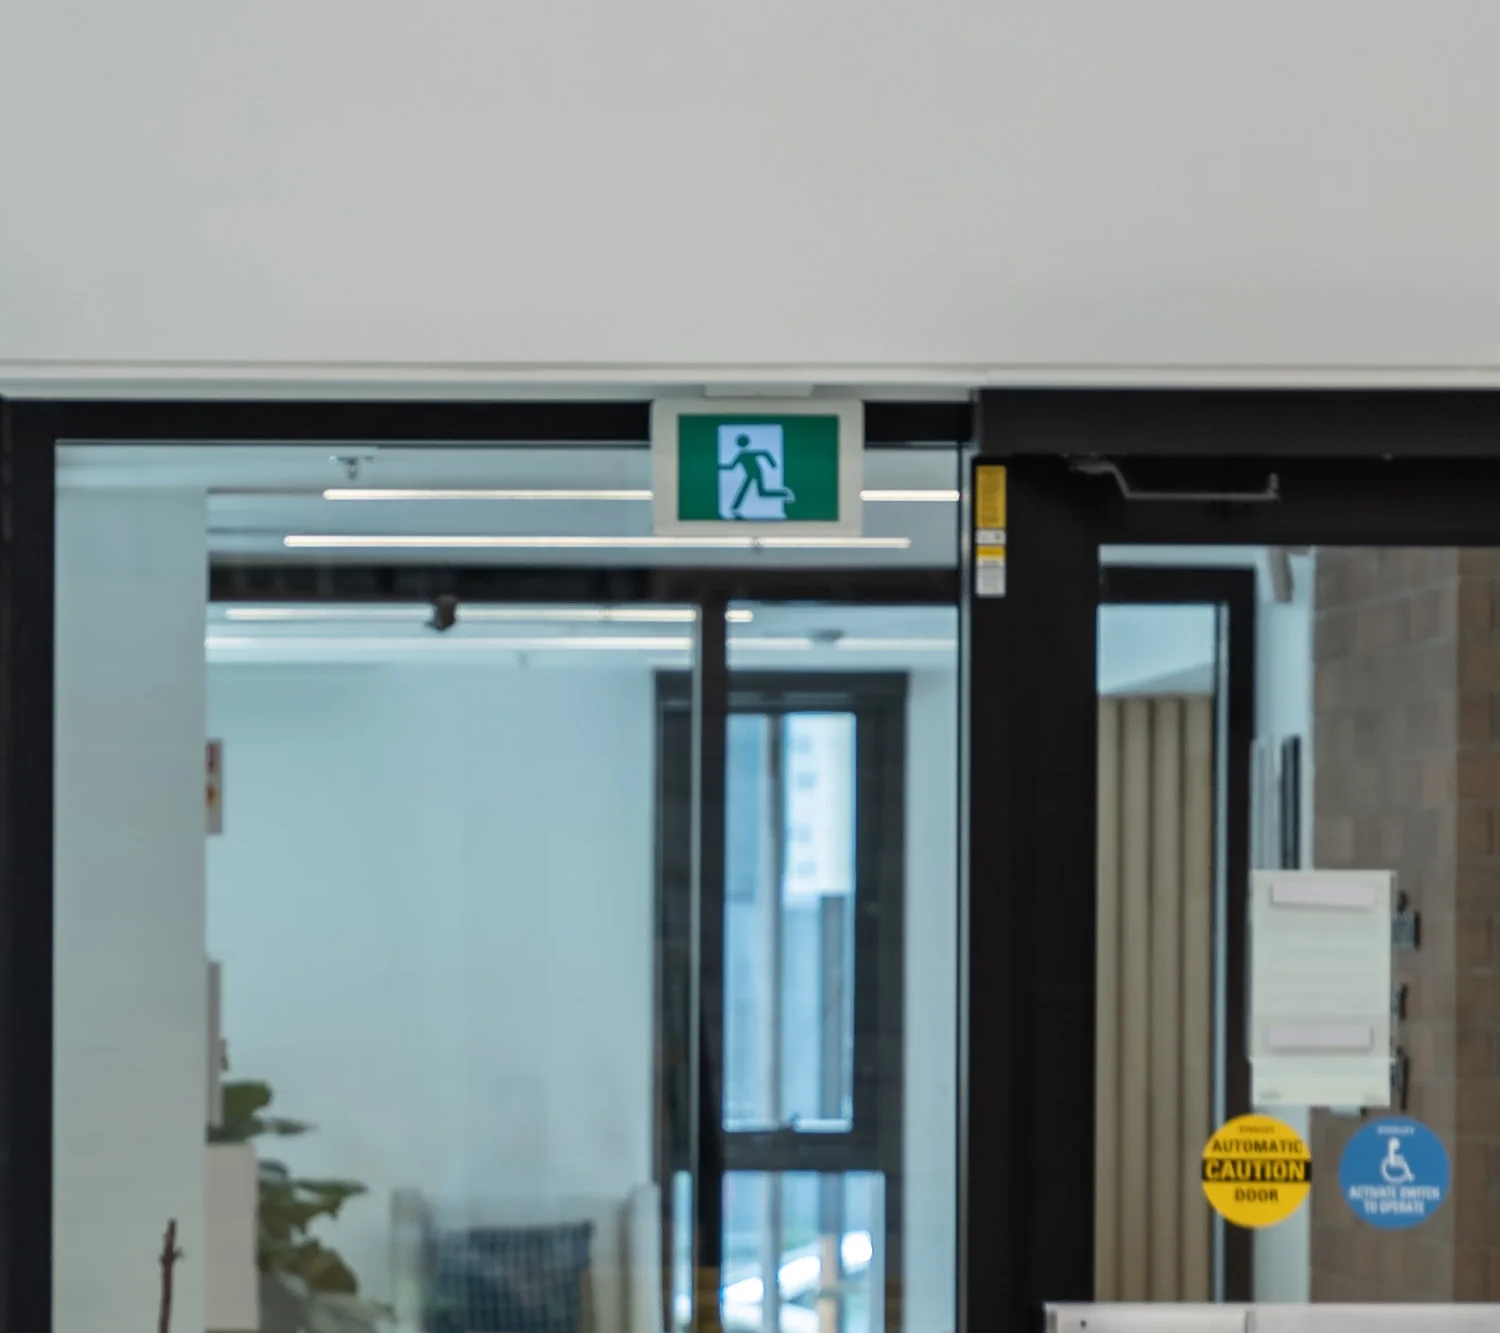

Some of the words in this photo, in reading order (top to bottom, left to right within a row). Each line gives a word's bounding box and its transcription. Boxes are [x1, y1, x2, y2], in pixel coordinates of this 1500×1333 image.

[1212, 1139, 1303, 1153] AUTOMATIC
[1205, 1160, 1305, 1180] CAUTION
[1234, 1188, 1279, 1202] DOOR
